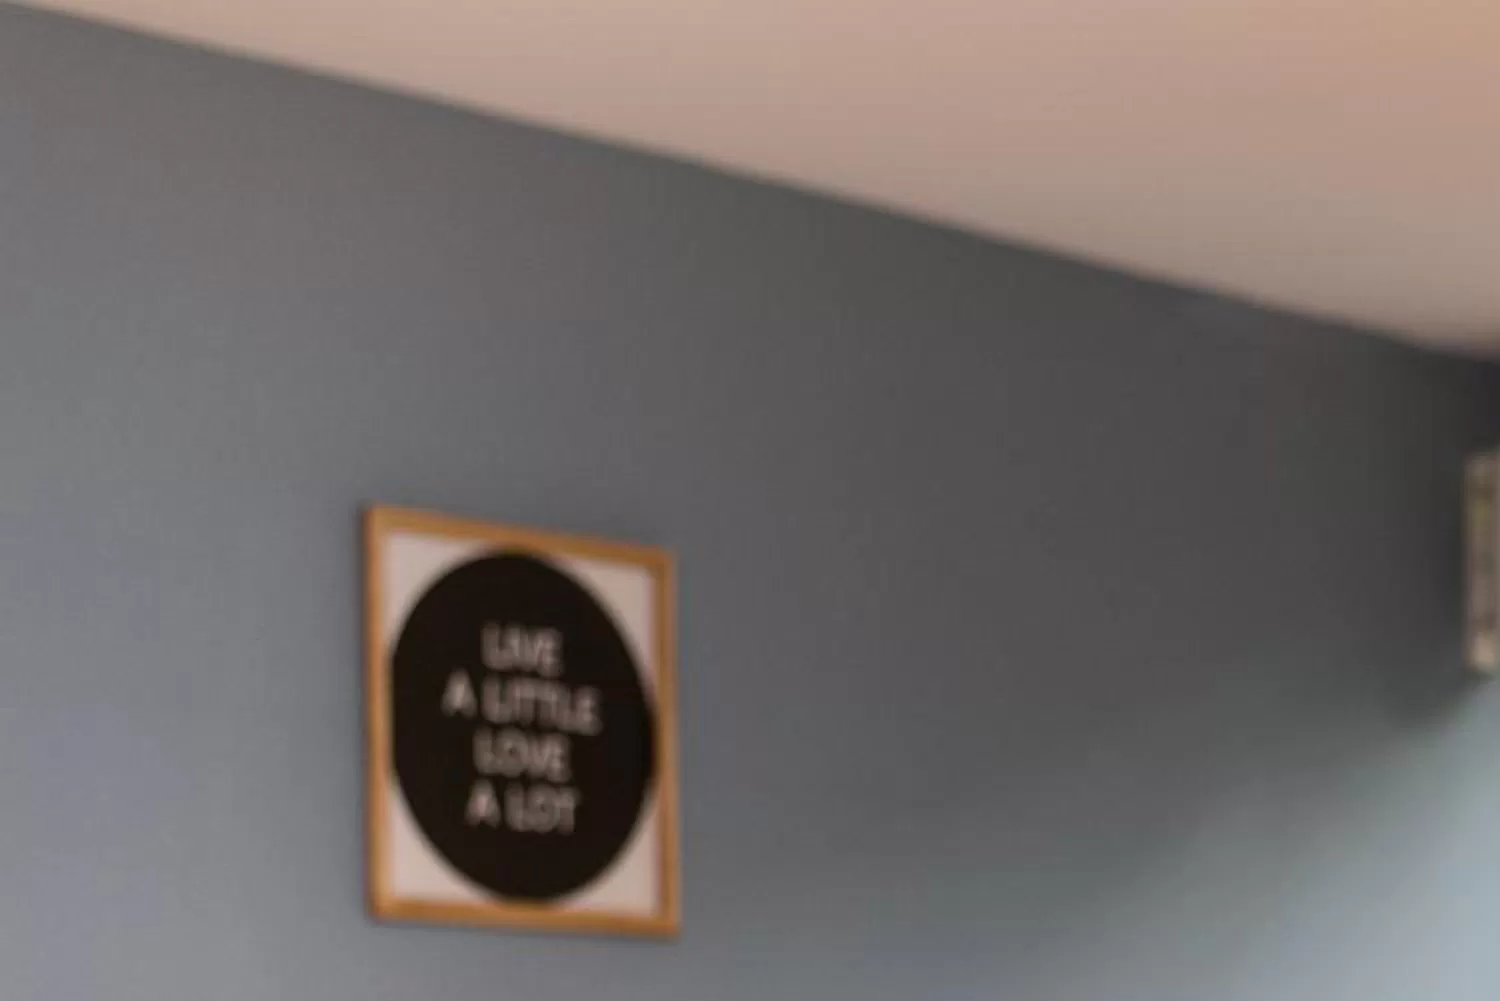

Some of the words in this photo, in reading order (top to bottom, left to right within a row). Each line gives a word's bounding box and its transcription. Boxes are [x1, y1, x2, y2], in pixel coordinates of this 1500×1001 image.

[481, 621, 564, 676] LIVE
[442, 668, 478, 718] A
[481, 674, 601, 736] LITTLE
[473, 727, 571, 783] LOVE
[465, 779, 501, 828] A
[504, 782, 578, 835] LOT
